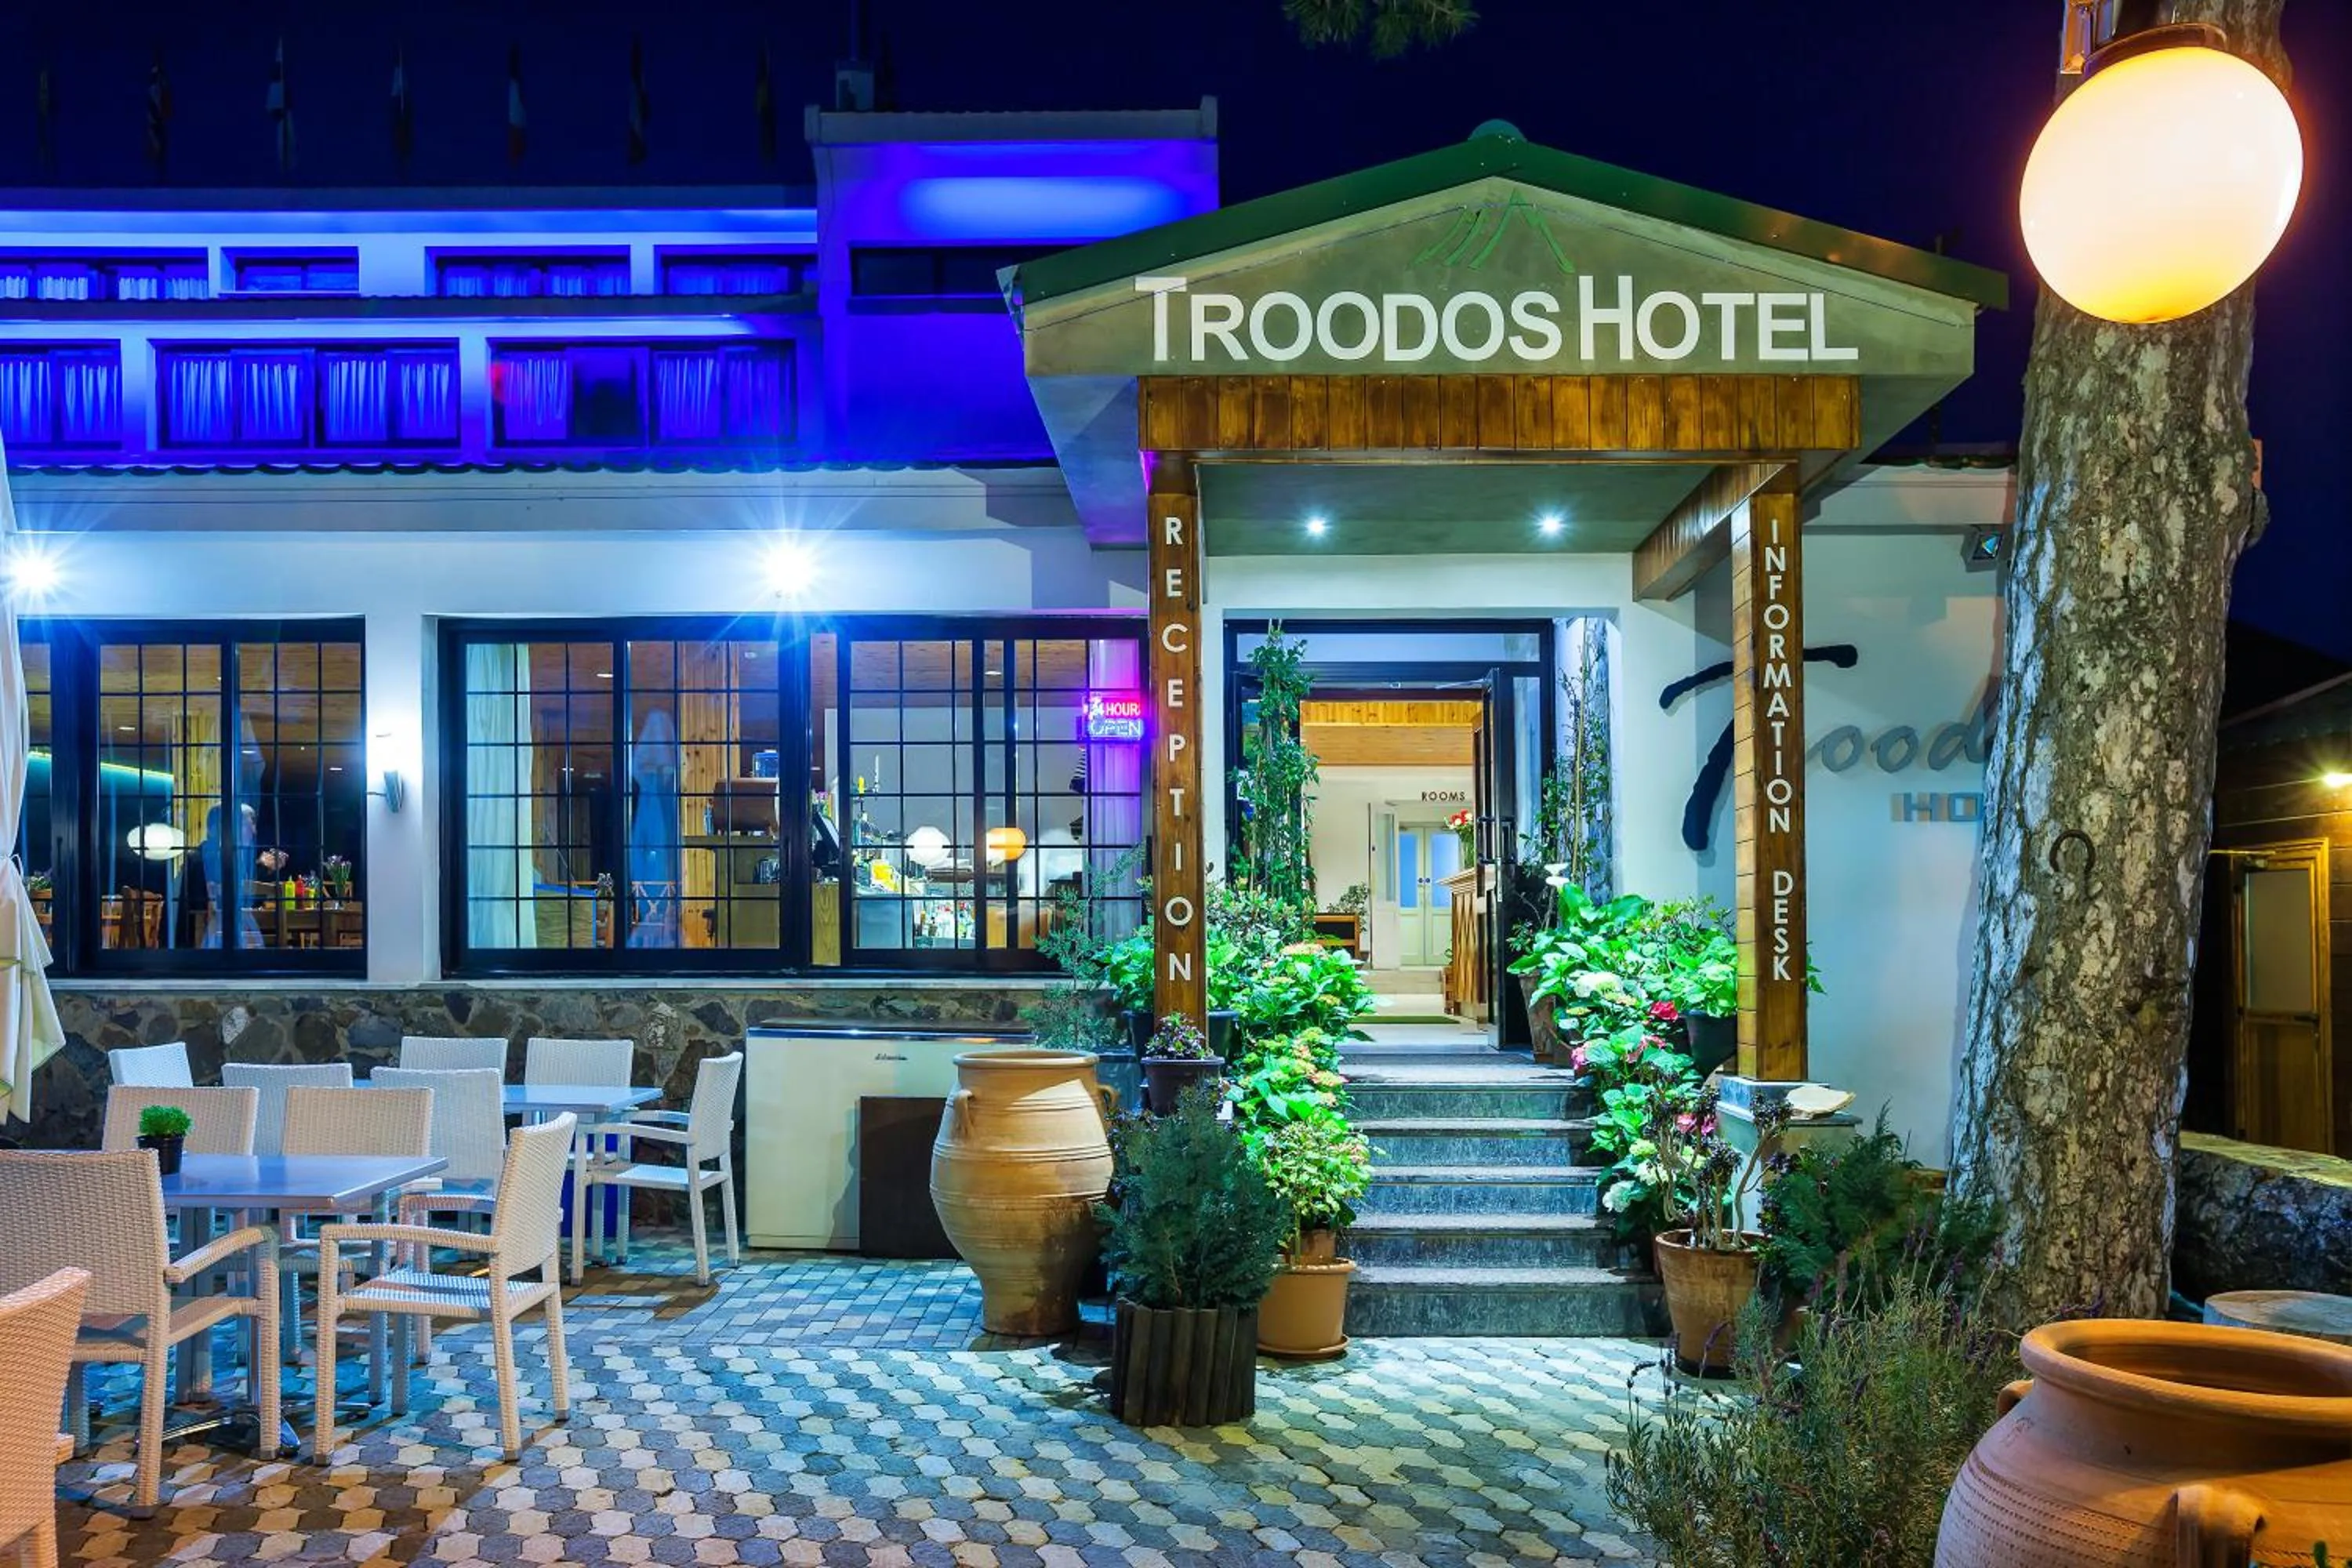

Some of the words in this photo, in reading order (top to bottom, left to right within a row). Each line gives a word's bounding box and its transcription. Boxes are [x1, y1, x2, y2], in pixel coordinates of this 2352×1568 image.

[1134, 275, 1564, 361] TROODOS
[1578, 274, 1860, 361] HOTEL
[1762, 519, 1793, 833] INFORMATION
[1090, 719, 1142, 736] OPEN
[1106, 702, 1142, 717] HOUR
[1162, 516, 1193, 982] RECEPTION
[1421, 790, 1466, 803] ROOMS
[1897, 791, 1984, 822] HO
[1773, 870, 1794, 982] DESK
